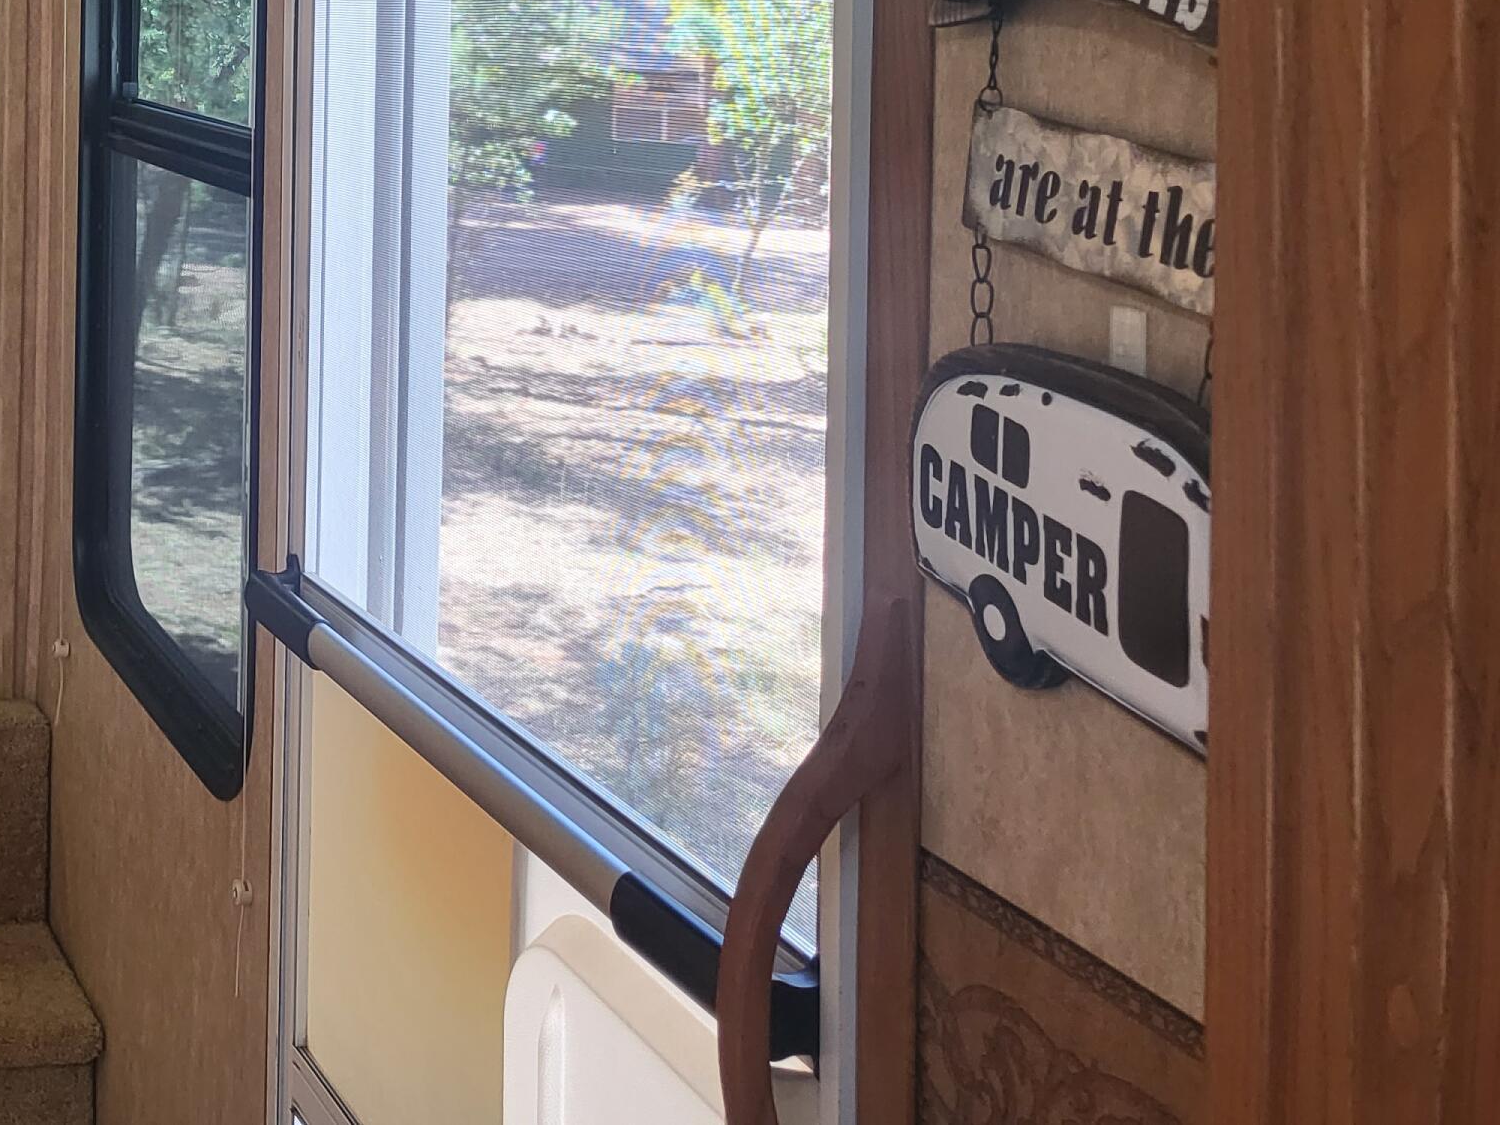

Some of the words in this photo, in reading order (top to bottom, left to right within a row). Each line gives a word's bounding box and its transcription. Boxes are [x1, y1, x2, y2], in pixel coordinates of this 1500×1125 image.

[989, 154, 1059, 224] are
[1071, 179, 1123, 246] at
[1139, 185, 1215, 278] the
[920, 443, 1108, 637] CAMPER
